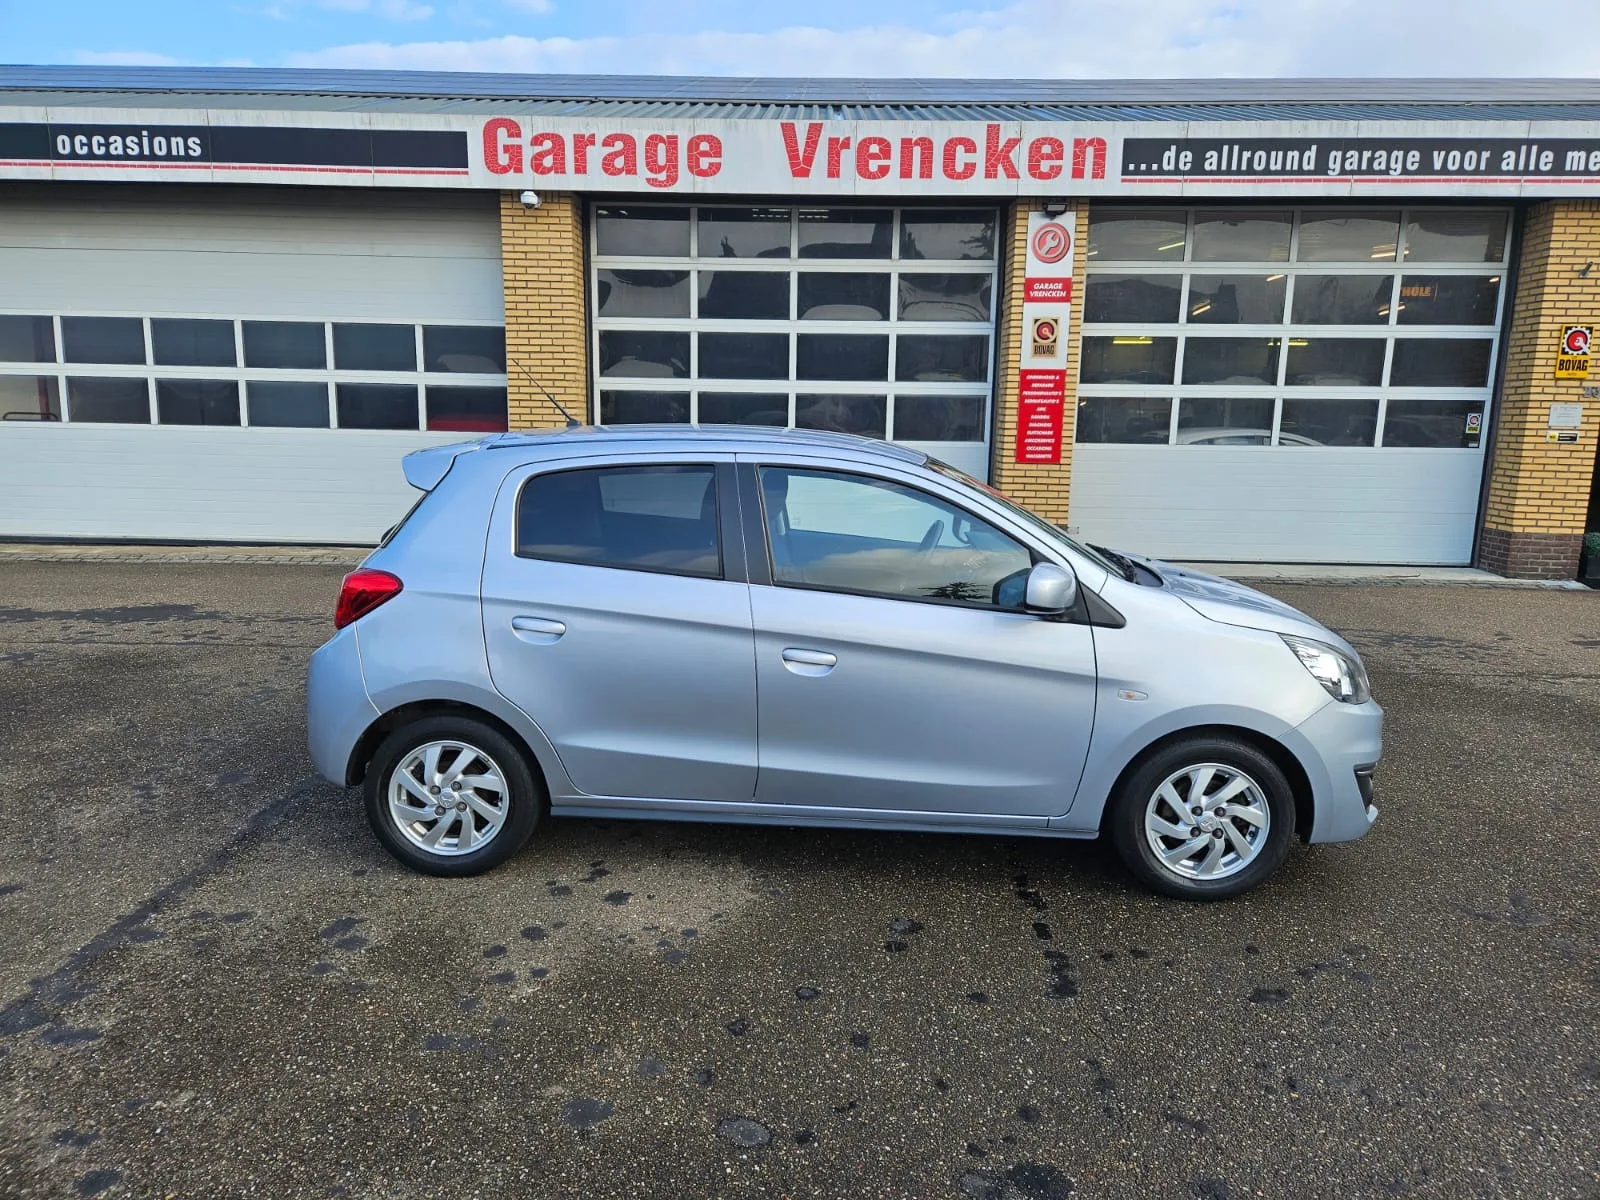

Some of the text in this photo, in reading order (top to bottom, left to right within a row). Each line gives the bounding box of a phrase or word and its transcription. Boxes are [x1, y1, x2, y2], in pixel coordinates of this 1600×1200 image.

[56, 130, 202, 157] occasions
[483, 117, 1107, 188] Garage Vrencken
[1204, 144, 1318, 171] allround
[1327, 150, 1421, 176] garage
[1432, 150, 1491, 171] voor
[1501, 144, 1554, 172] alle
[1565, 150, 1600, 172] me
[1033, 282, 1063, 290] GARAGE
[1029, 290, 1067, 298] VRENCKEN
[1033, 344, 1055, 355] BOVAG
[1558, 358, 1589, 371] BOVAG
